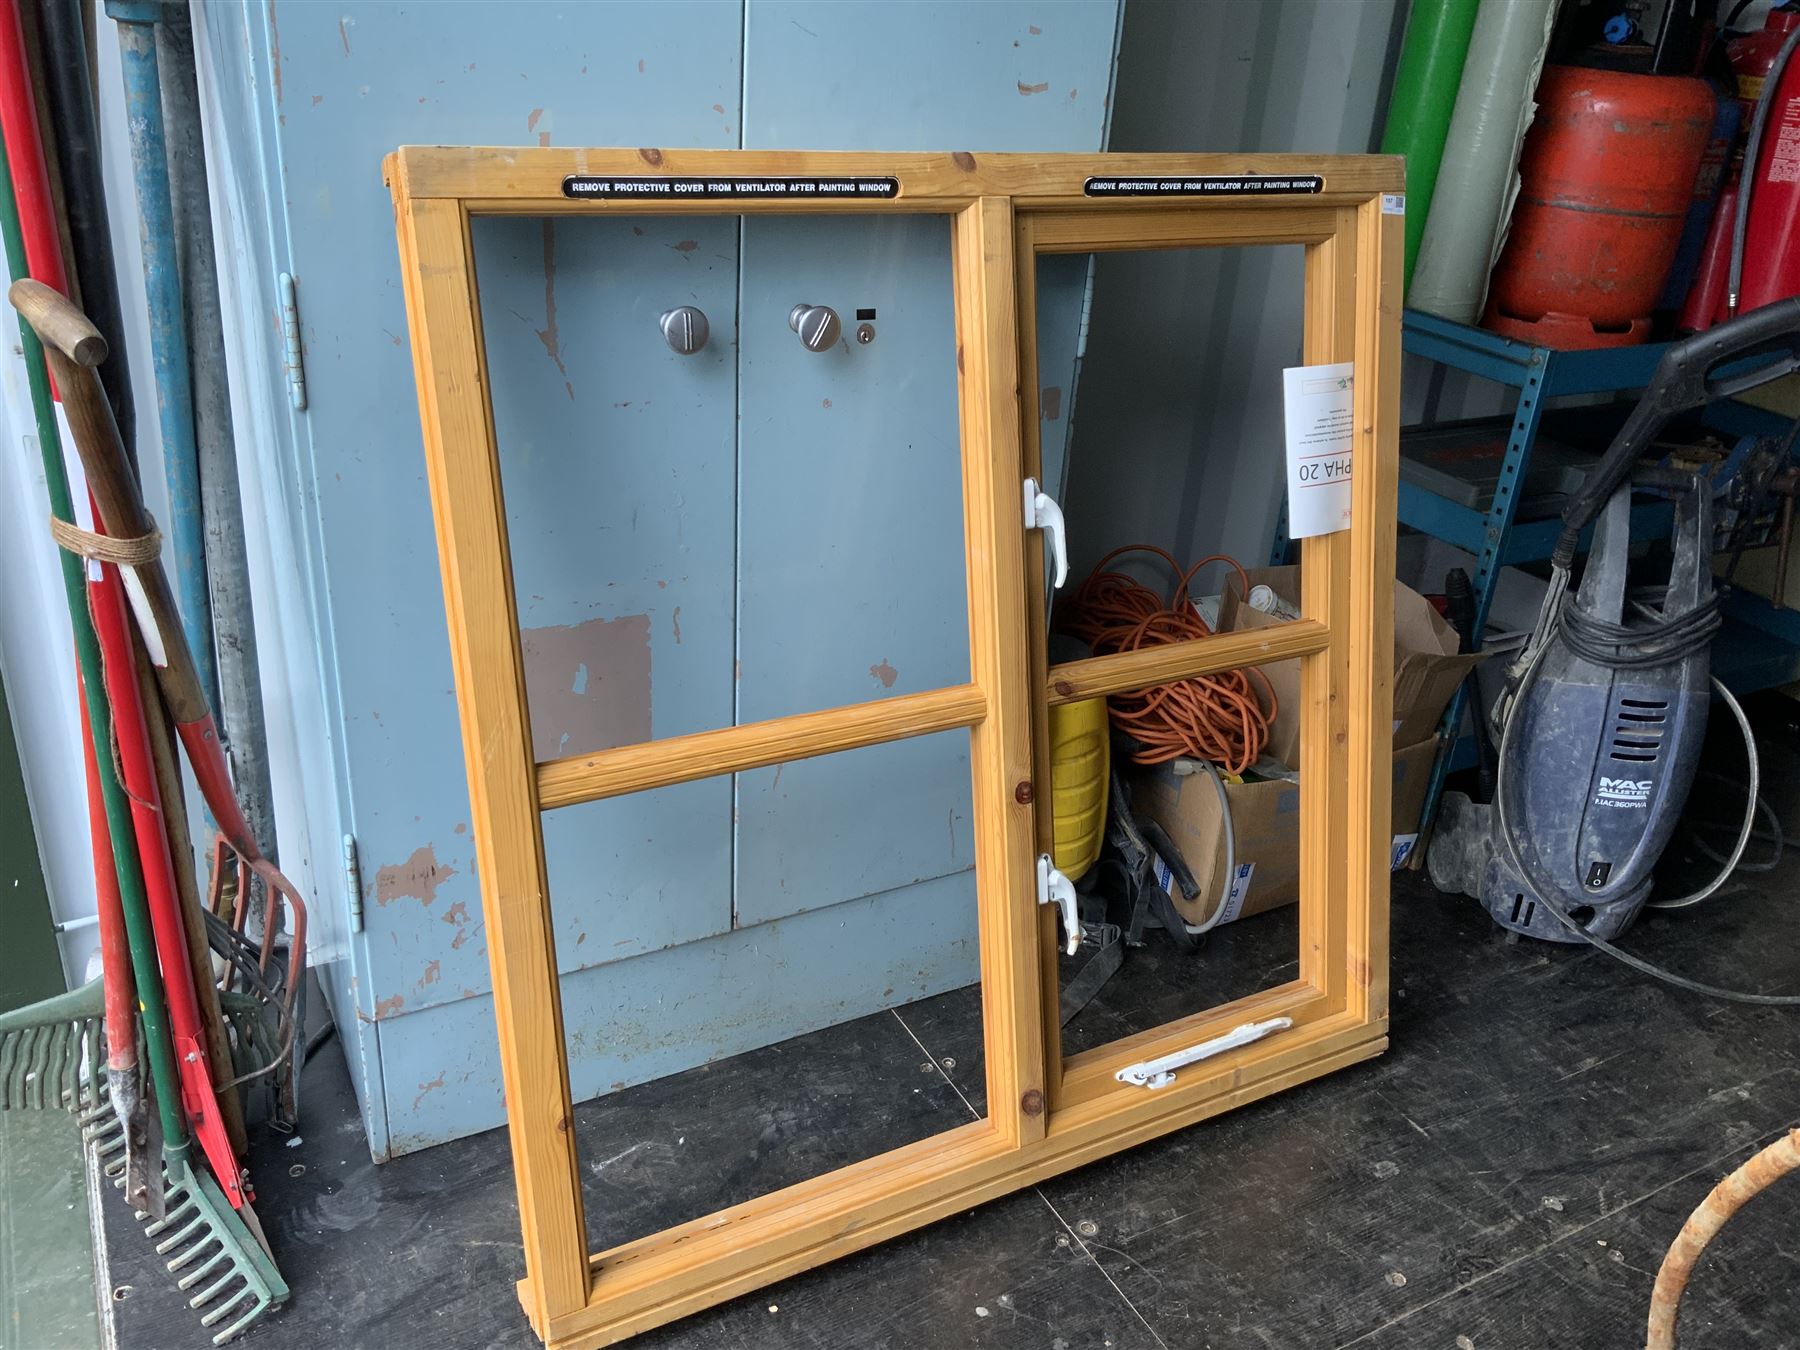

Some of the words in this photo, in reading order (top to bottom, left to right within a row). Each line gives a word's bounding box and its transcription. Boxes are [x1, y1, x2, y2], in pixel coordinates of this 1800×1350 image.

[572, 183, 610, 192] REMOVE
[615, 183, 670, 192] PROTECTIVE
[674, 184, 704, 192] COVER
[708, 184, 732, 192] FROM
[735, 183, 786, 192] VENTILATOR
[789, 183, 815, 192] AFTER
[818, 183, 855, 192] PAINTING
[859, 183, 891, 192] WINDOW
[1118, 182, 1158, 190] PROTECTIVE
[1160, 182, 1182, 190] COVER
[1184, 182, 1202, 190] FROM
[1204, 182, 1241, 190] VENTILATOR
[1299, 463, 1319, 481] 20
[1599, 776, 1653, 790] MAC
[1598, 787, 1650, 795] ALLISTER
